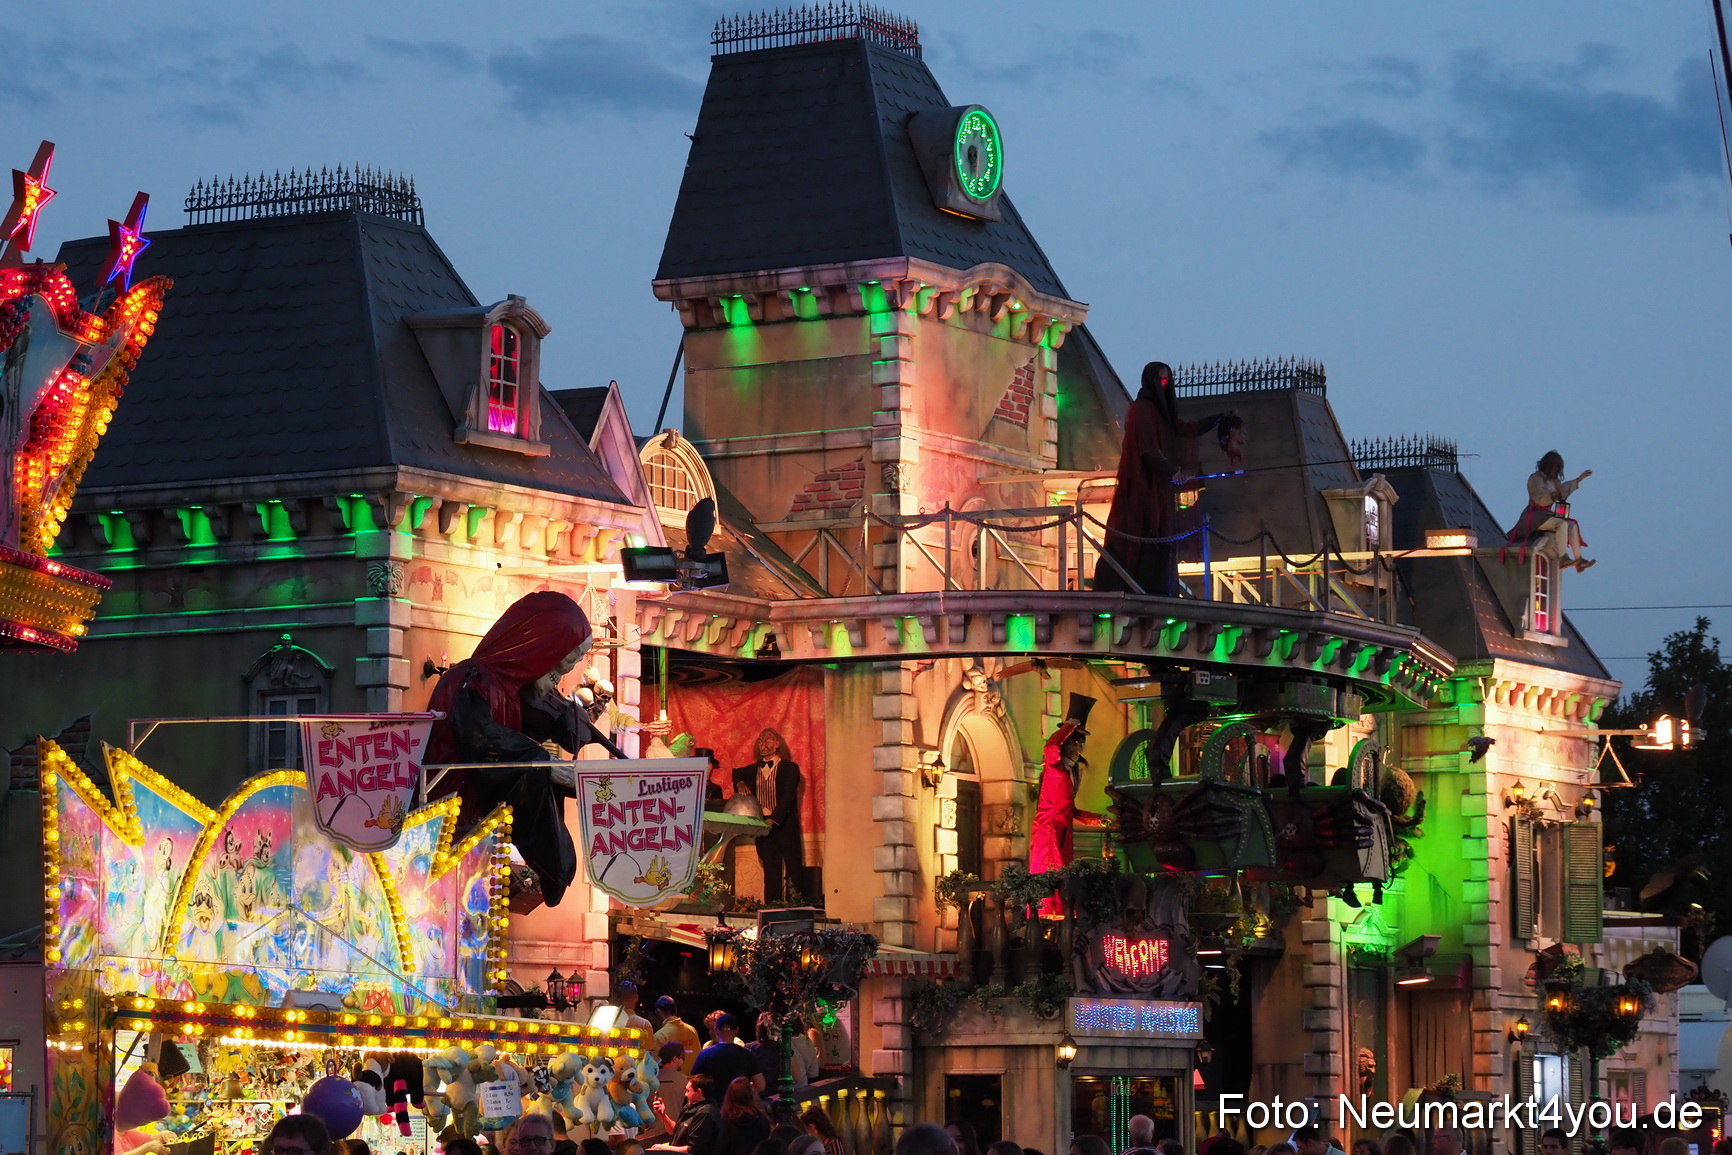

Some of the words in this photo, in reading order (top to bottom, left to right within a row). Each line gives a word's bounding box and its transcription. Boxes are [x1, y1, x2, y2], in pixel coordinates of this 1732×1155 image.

[318, 729, 421, 768] ENTEN-
[316, 760, 421, 804] ANGELN
[637, 776, 693, 797] Lustiges
[591, 797, 686, 829] ENTEN-
[590, 824, 694, 860] ANGELN
[1102, 934, 1169, 978] WELCOME
[150, 1009, 221, 1027] LUSTIGE
